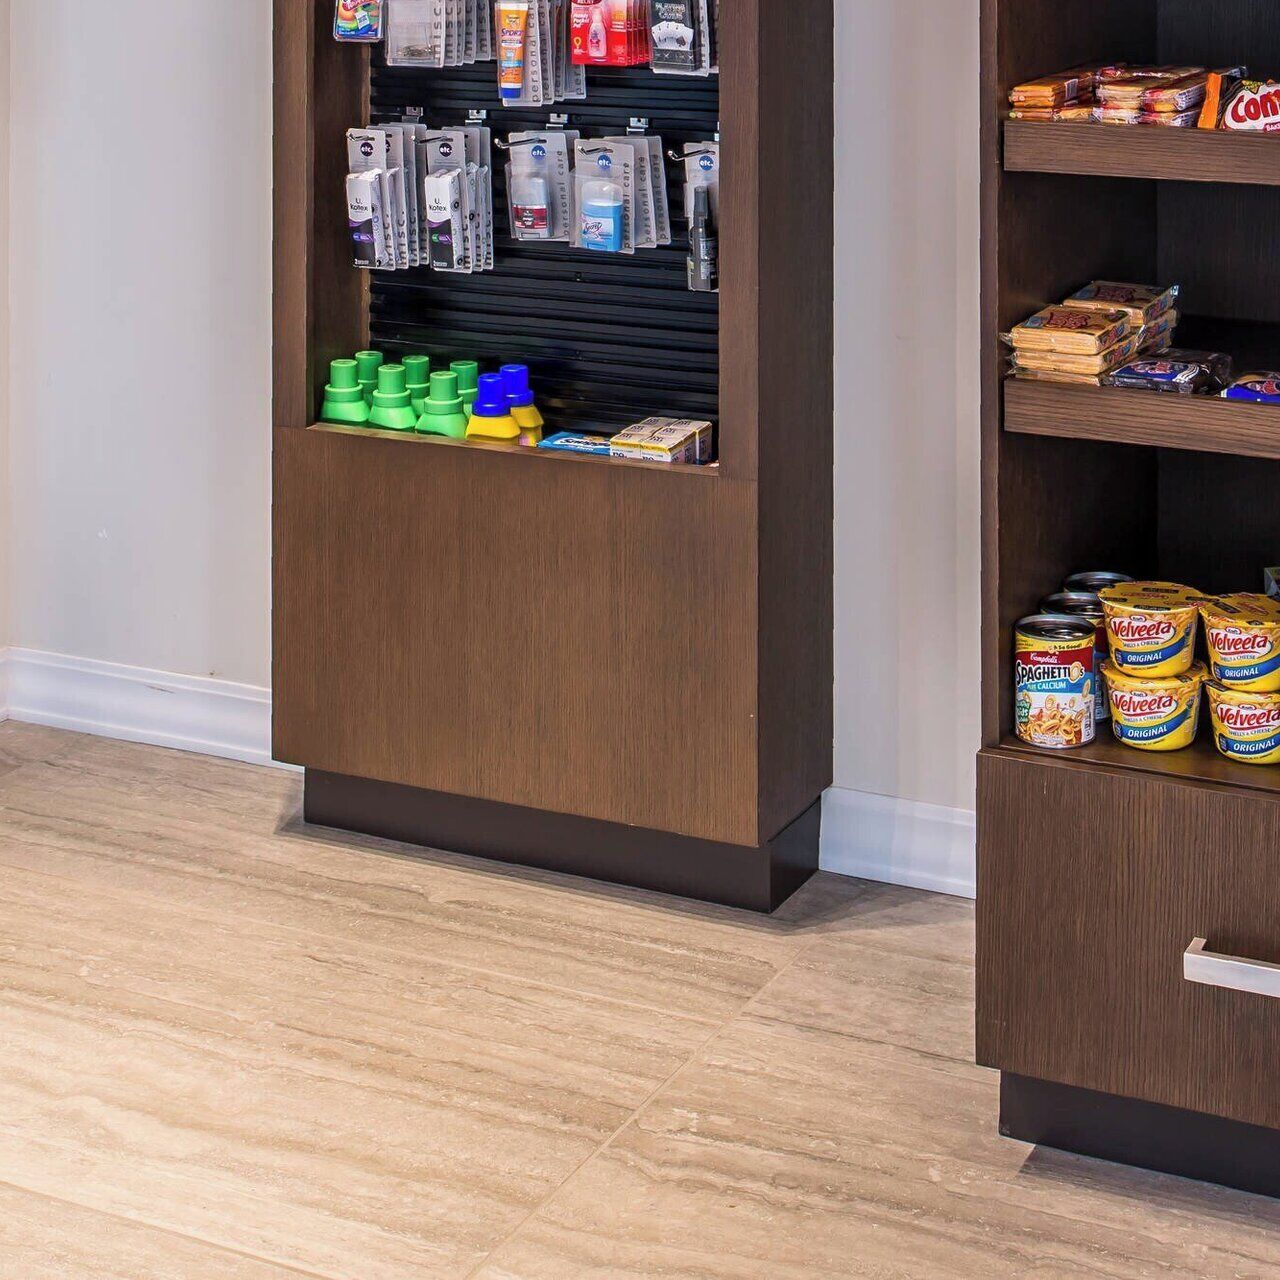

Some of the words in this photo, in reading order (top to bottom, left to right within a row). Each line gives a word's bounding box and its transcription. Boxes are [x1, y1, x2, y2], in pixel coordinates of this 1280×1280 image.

[528, 34, 540, 103] personal
[1113, 621, 1171, 638] Velveeta
[1210, 636, 1269, 651] Velveeta
[1127, 652, 1162, 662] ORIGINAL
[1225, 668, 1258, 677] ORIGINAL
[1114, 695, 1173, 712] Velveeta
[1219, 710, 1280, 725] Velveeta
[1128, 725, 1167, 738] ORIGINAL
[1234, 740, 1275, 751] ORIGINAL
